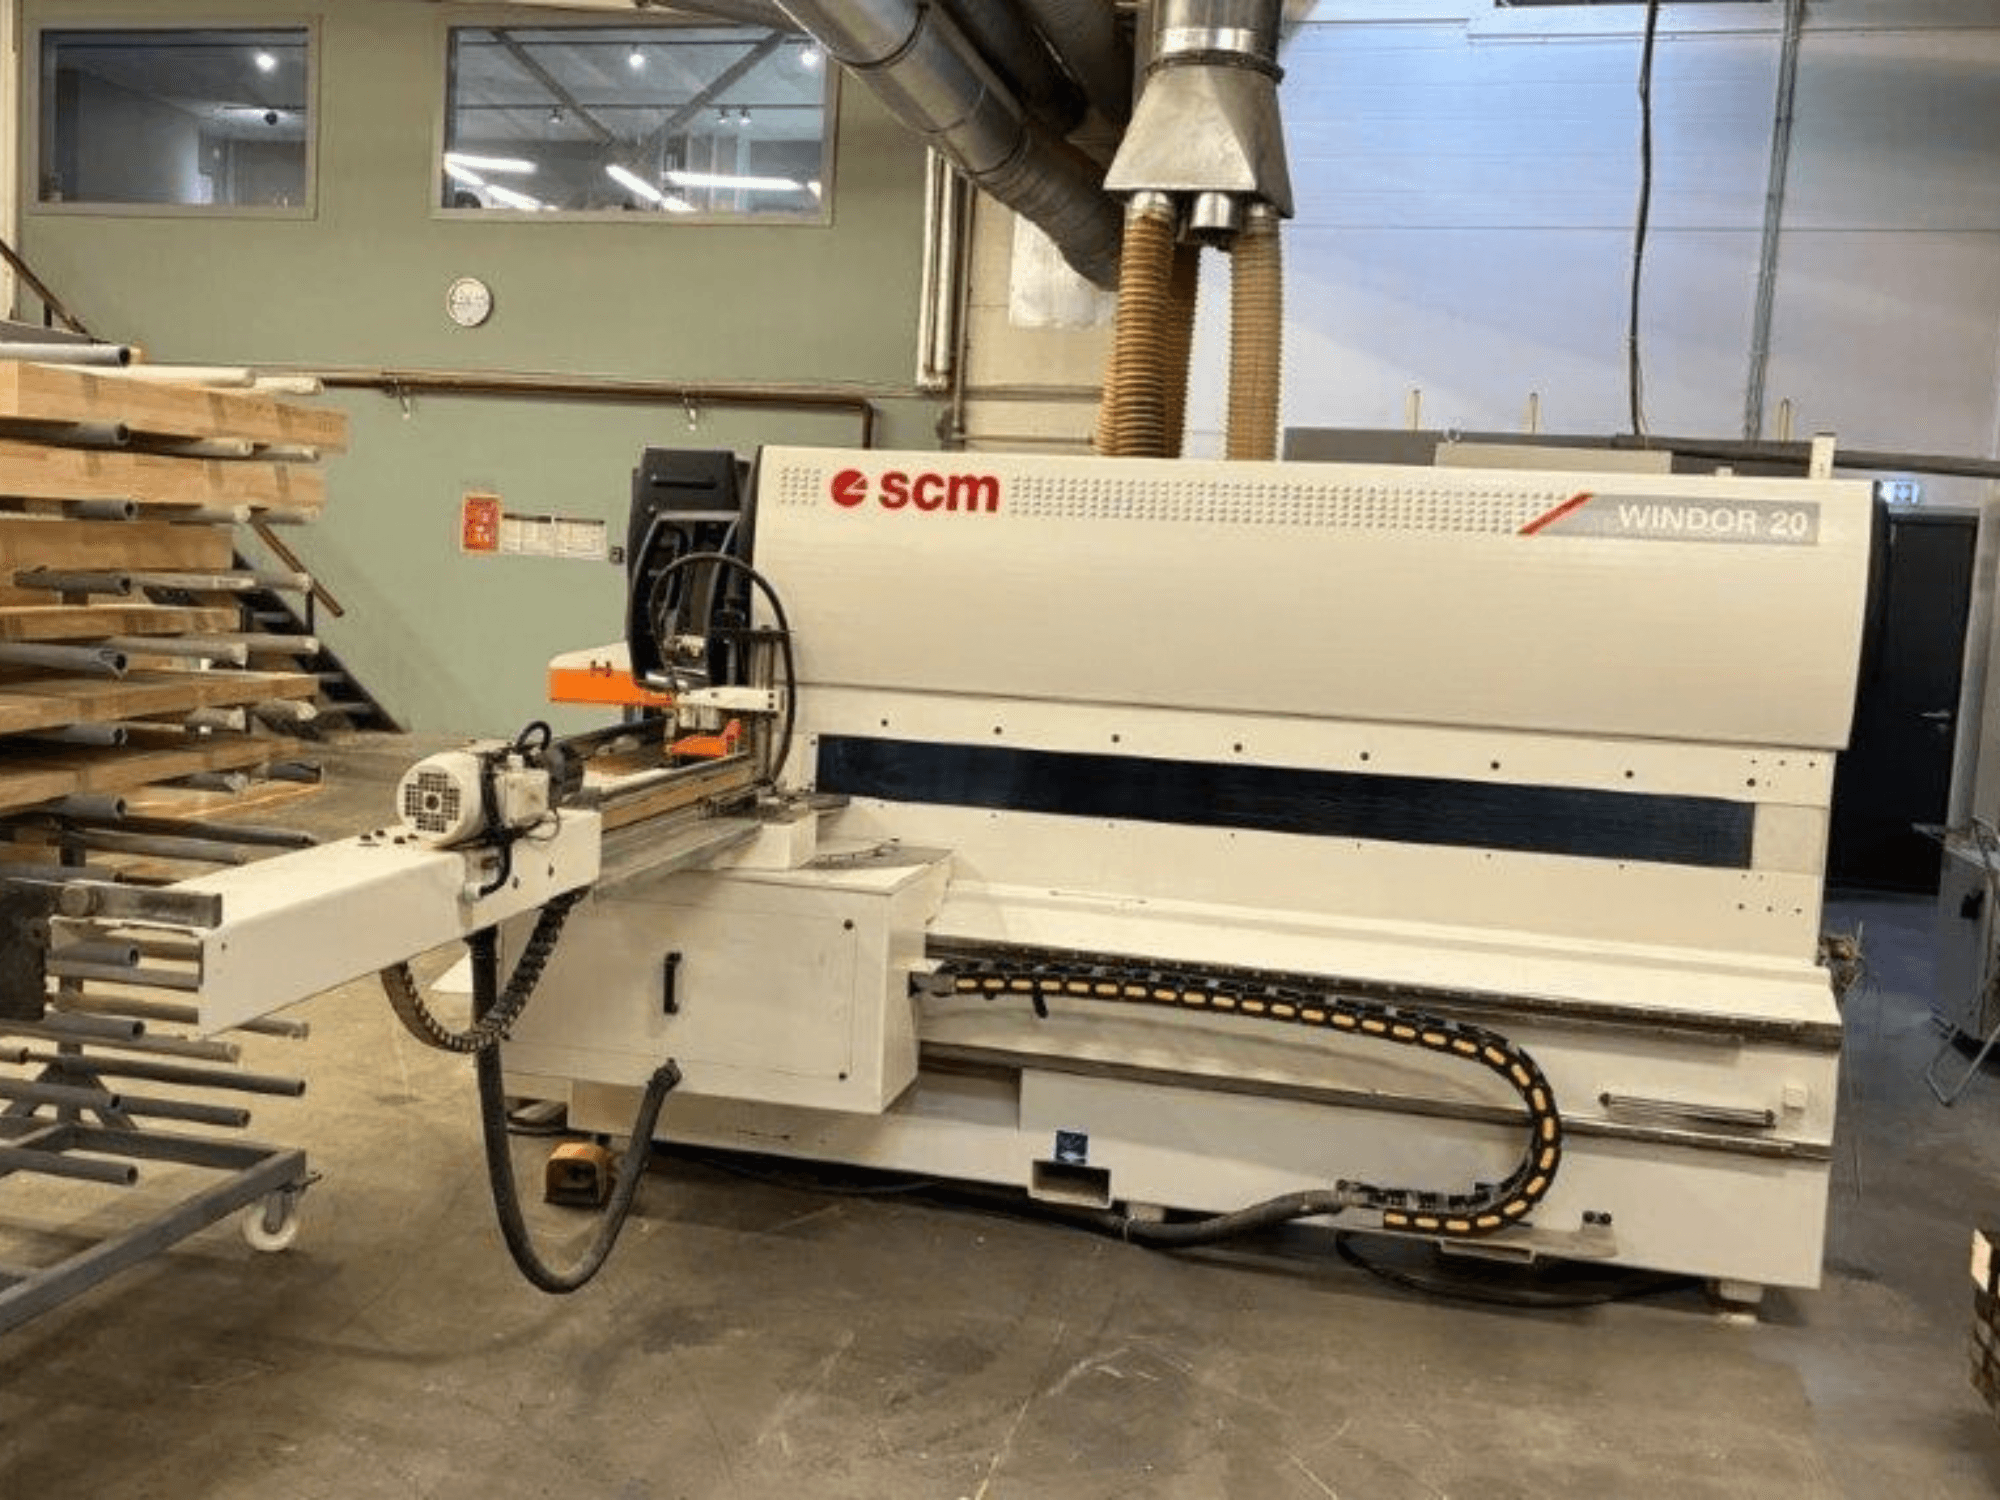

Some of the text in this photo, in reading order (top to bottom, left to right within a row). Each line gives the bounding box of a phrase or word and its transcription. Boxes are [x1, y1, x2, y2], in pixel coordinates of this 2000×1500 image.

[877, 470, 1000, 513] scm
[1617, 503, 1809, 536] WINDOR 20
